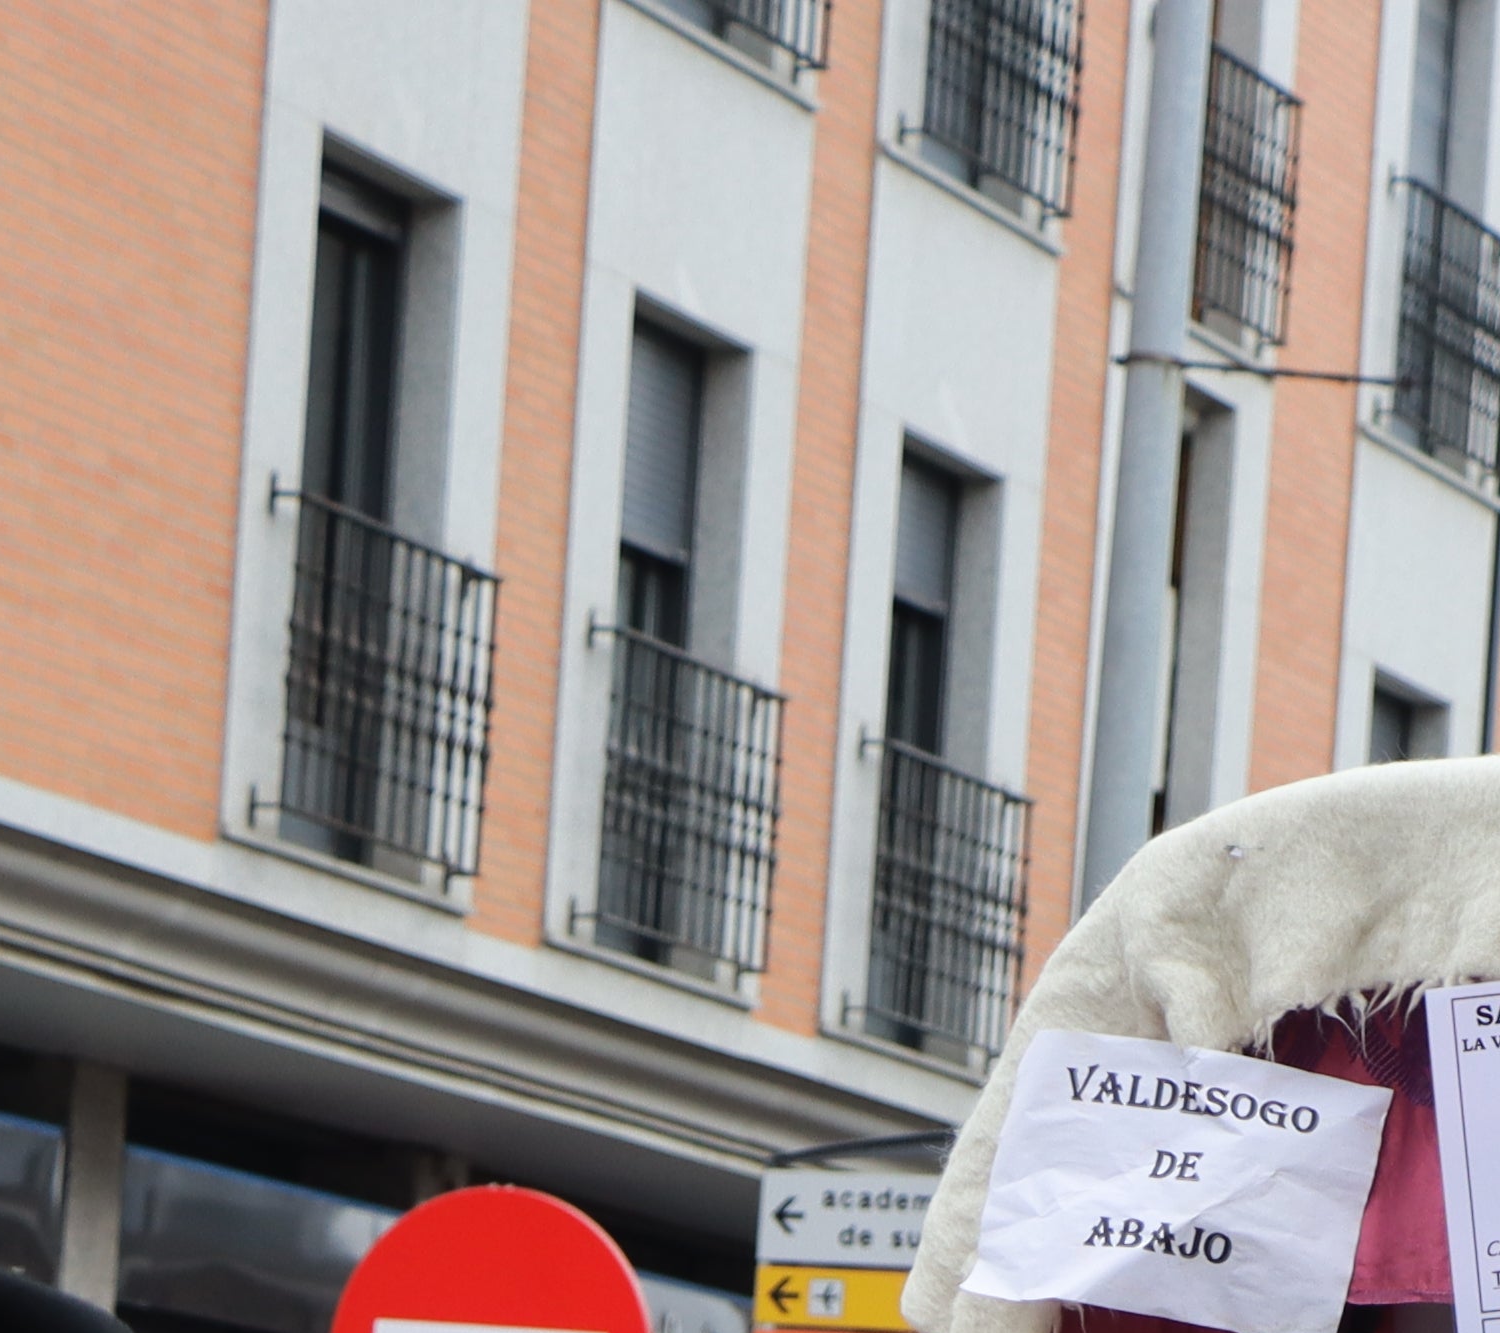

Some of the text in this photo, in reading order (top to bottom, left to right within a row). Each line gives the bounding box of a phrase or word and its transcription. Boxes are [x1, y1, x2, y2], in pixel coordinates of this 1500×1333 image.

[1462, 1037, 1486, 1052] LA
[1067, 1063, 1321, 1134] VALDESOGO
[1148, 1149, 1204, 1181] DE
[838, 1223, 872, 1247] de
[1083, 1216, 1233, 1265] ABAJO
